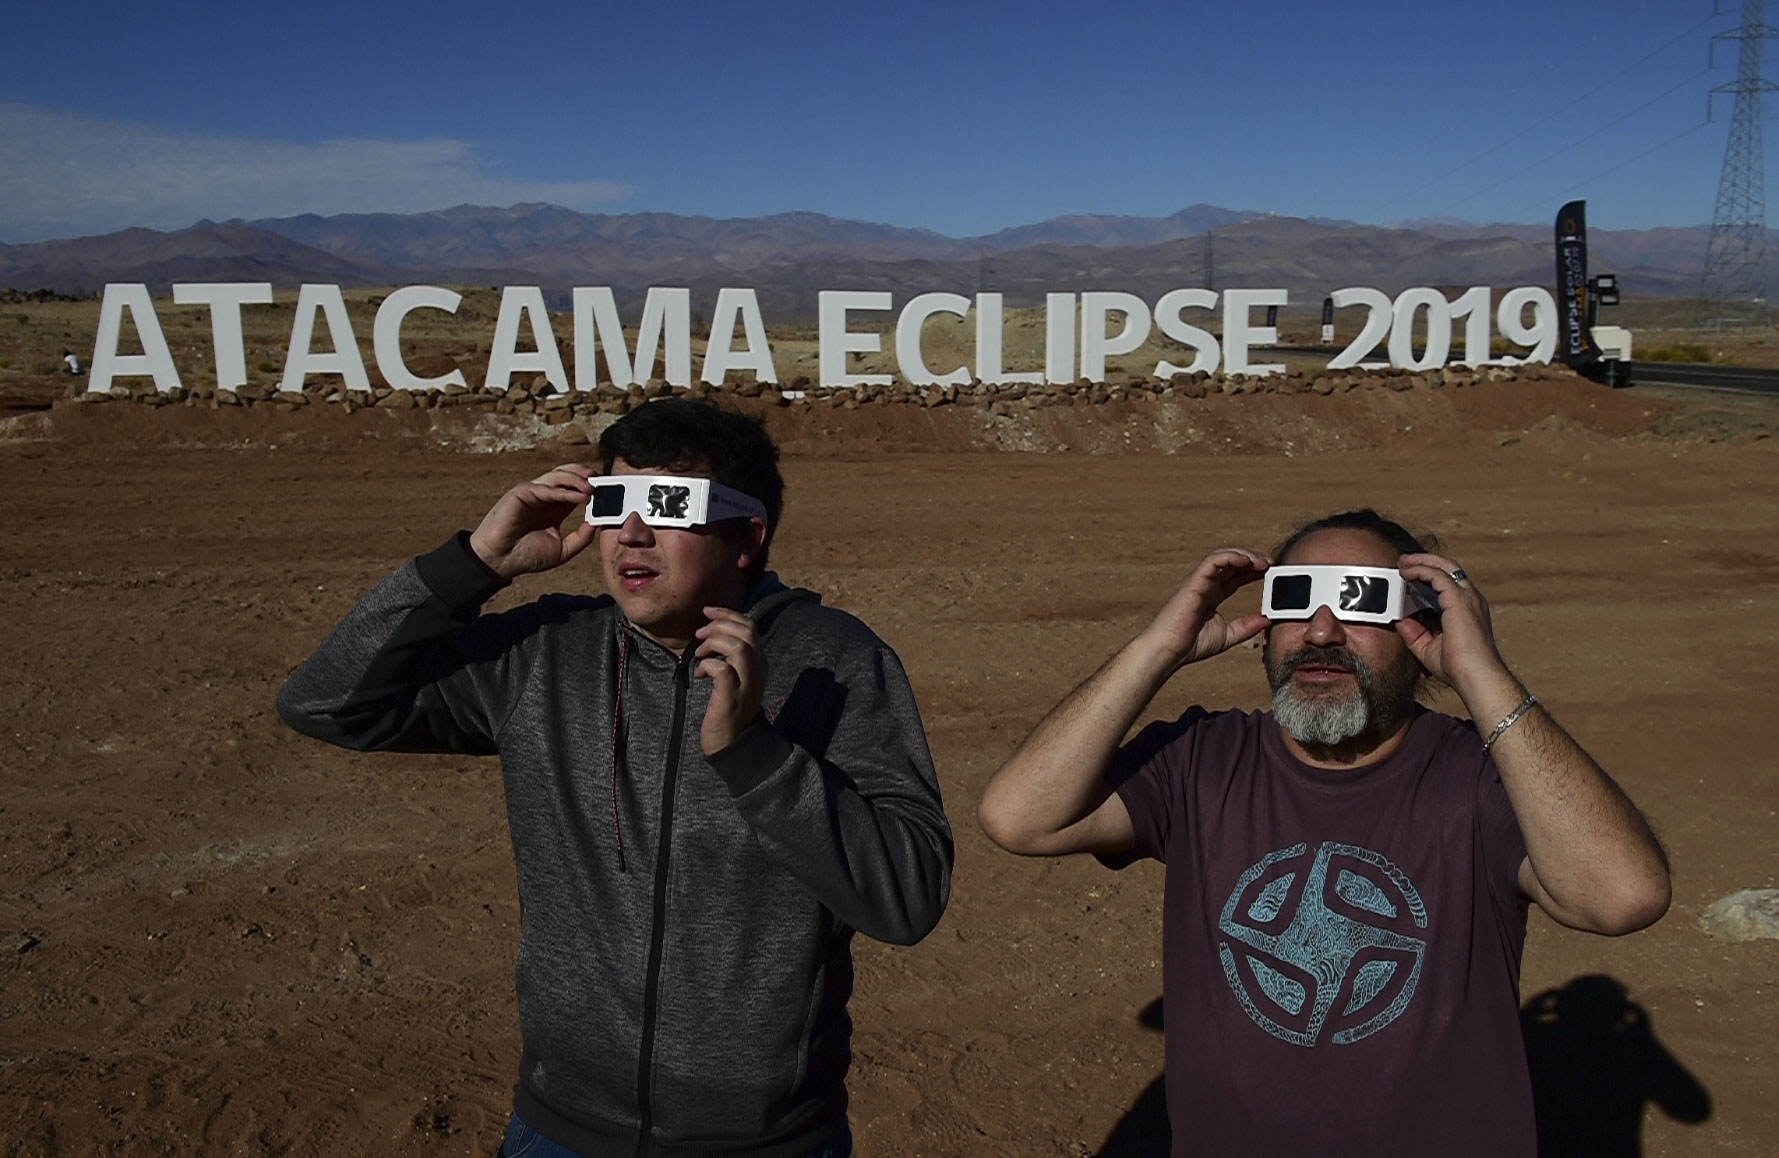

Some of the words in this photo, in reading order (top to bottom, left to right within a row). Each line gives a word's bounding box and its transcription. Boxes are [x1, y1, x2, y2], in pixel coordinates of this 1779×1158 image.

[87, 283, 778, 394] ATACAMA
[818, 288, 1288, 388] ECLIPSE
[1326, 286, 1558, 372] 2019
[1569, 299, 1581, 355] ECLIPSE
